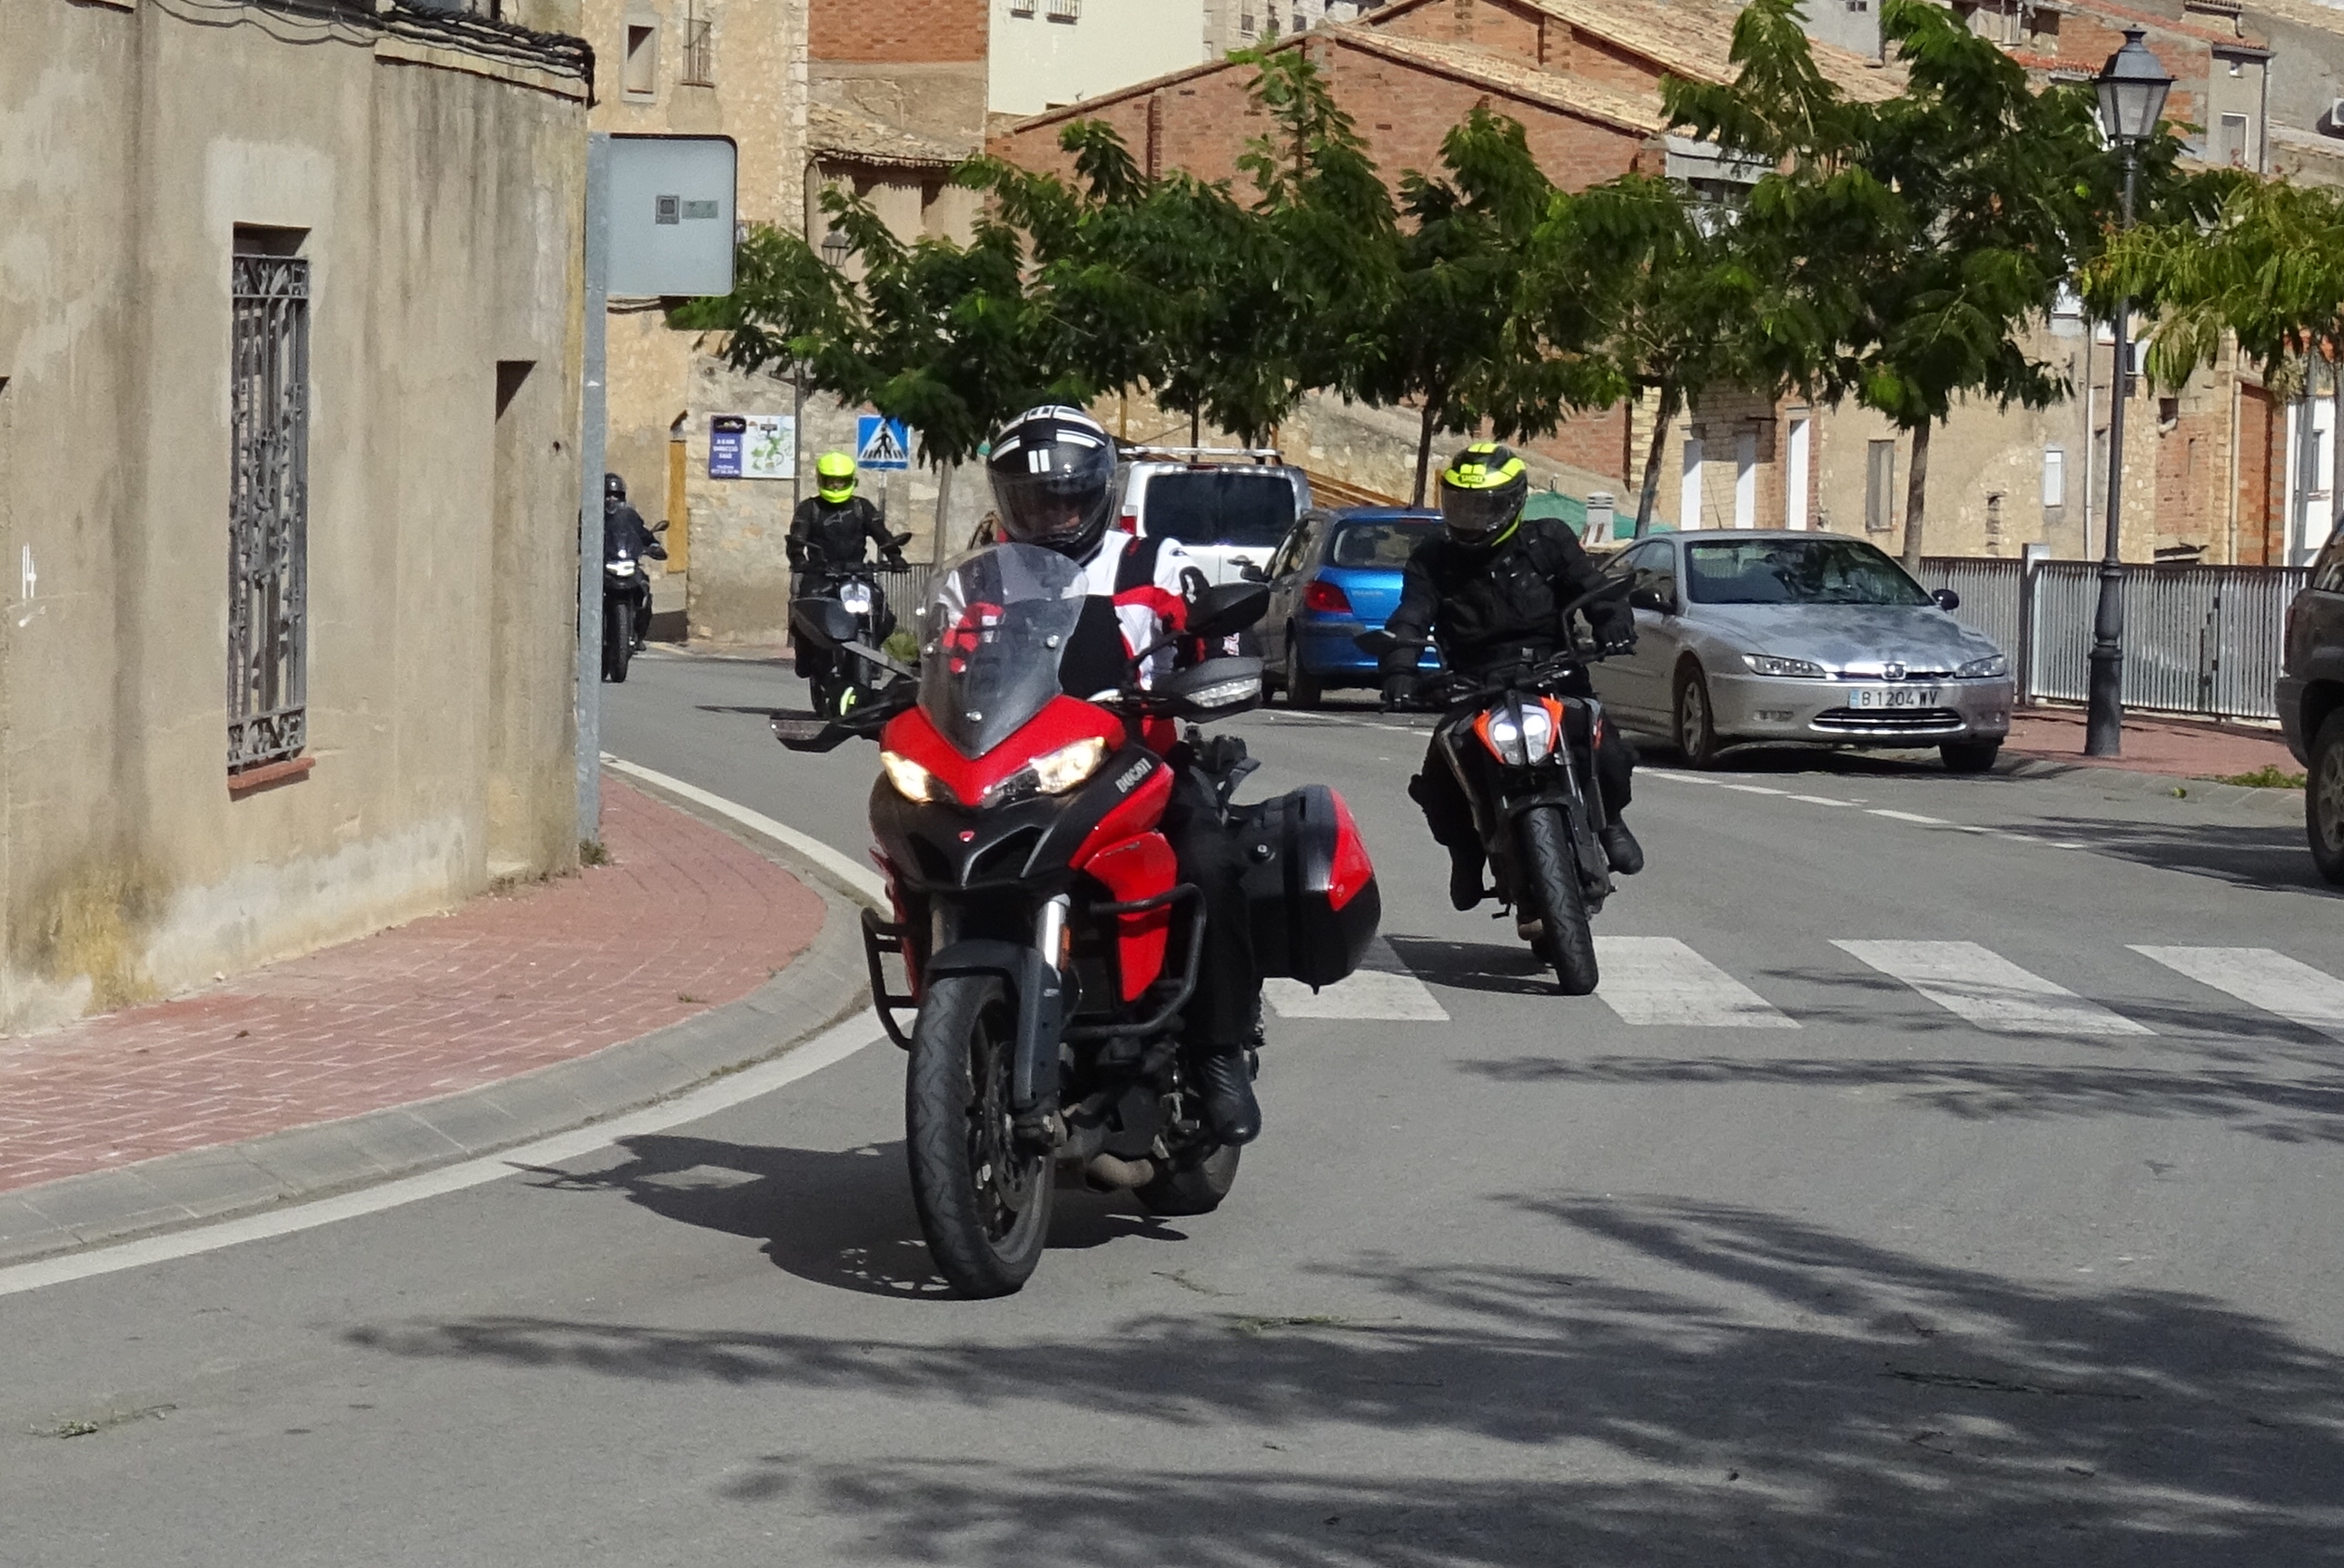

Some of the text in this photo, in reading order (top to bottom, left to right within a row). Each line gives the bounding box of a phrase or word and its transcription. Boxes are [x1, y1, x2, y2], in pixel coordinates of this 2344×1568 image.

[1862, 691, 1871, 706] B
[1877, 691, 1914, 706] 1204
[1115, 757, 1152, 793] DUCATI
